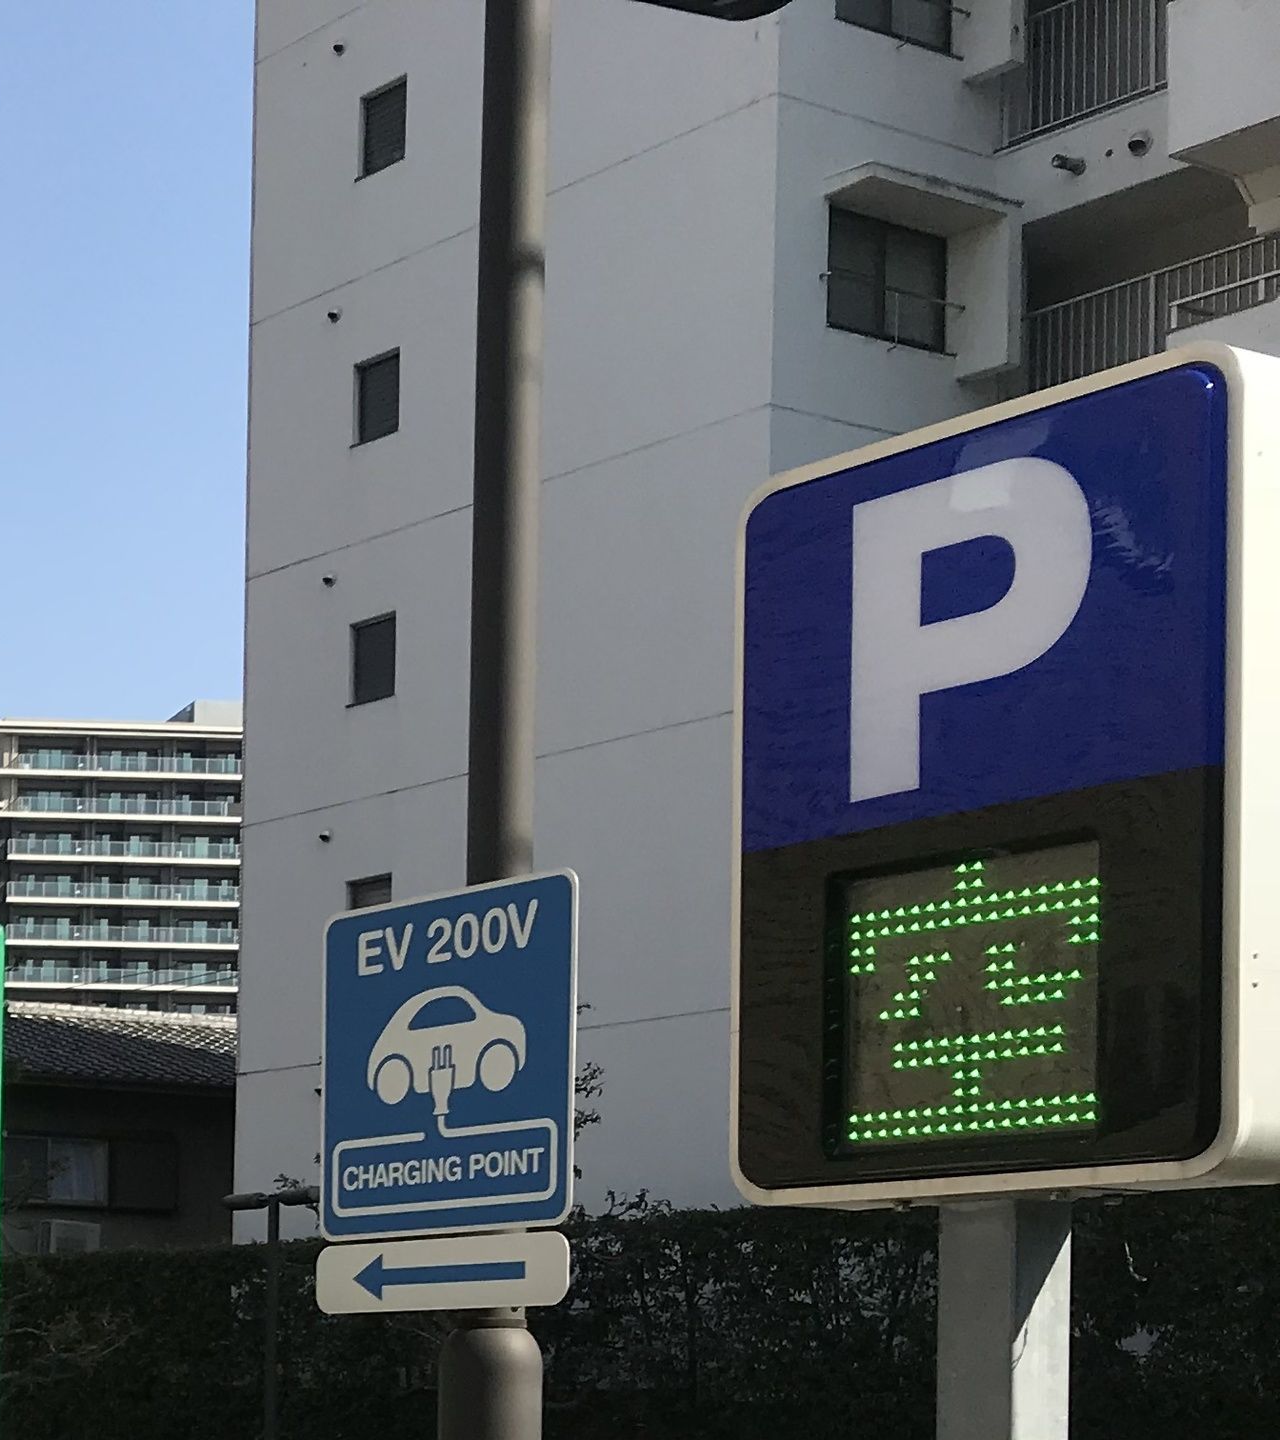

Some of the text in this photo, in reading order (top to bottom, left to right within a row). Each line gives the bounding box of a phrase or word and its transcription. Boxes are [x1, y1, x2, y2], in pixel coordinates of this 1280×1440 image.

[850, 456, 1093, 803] P
[357, 898, 539, 977] EV 200V
[849, 859, 1102, 1142] 空
[342, 1146, 545, 1193] CHARGING POINT
